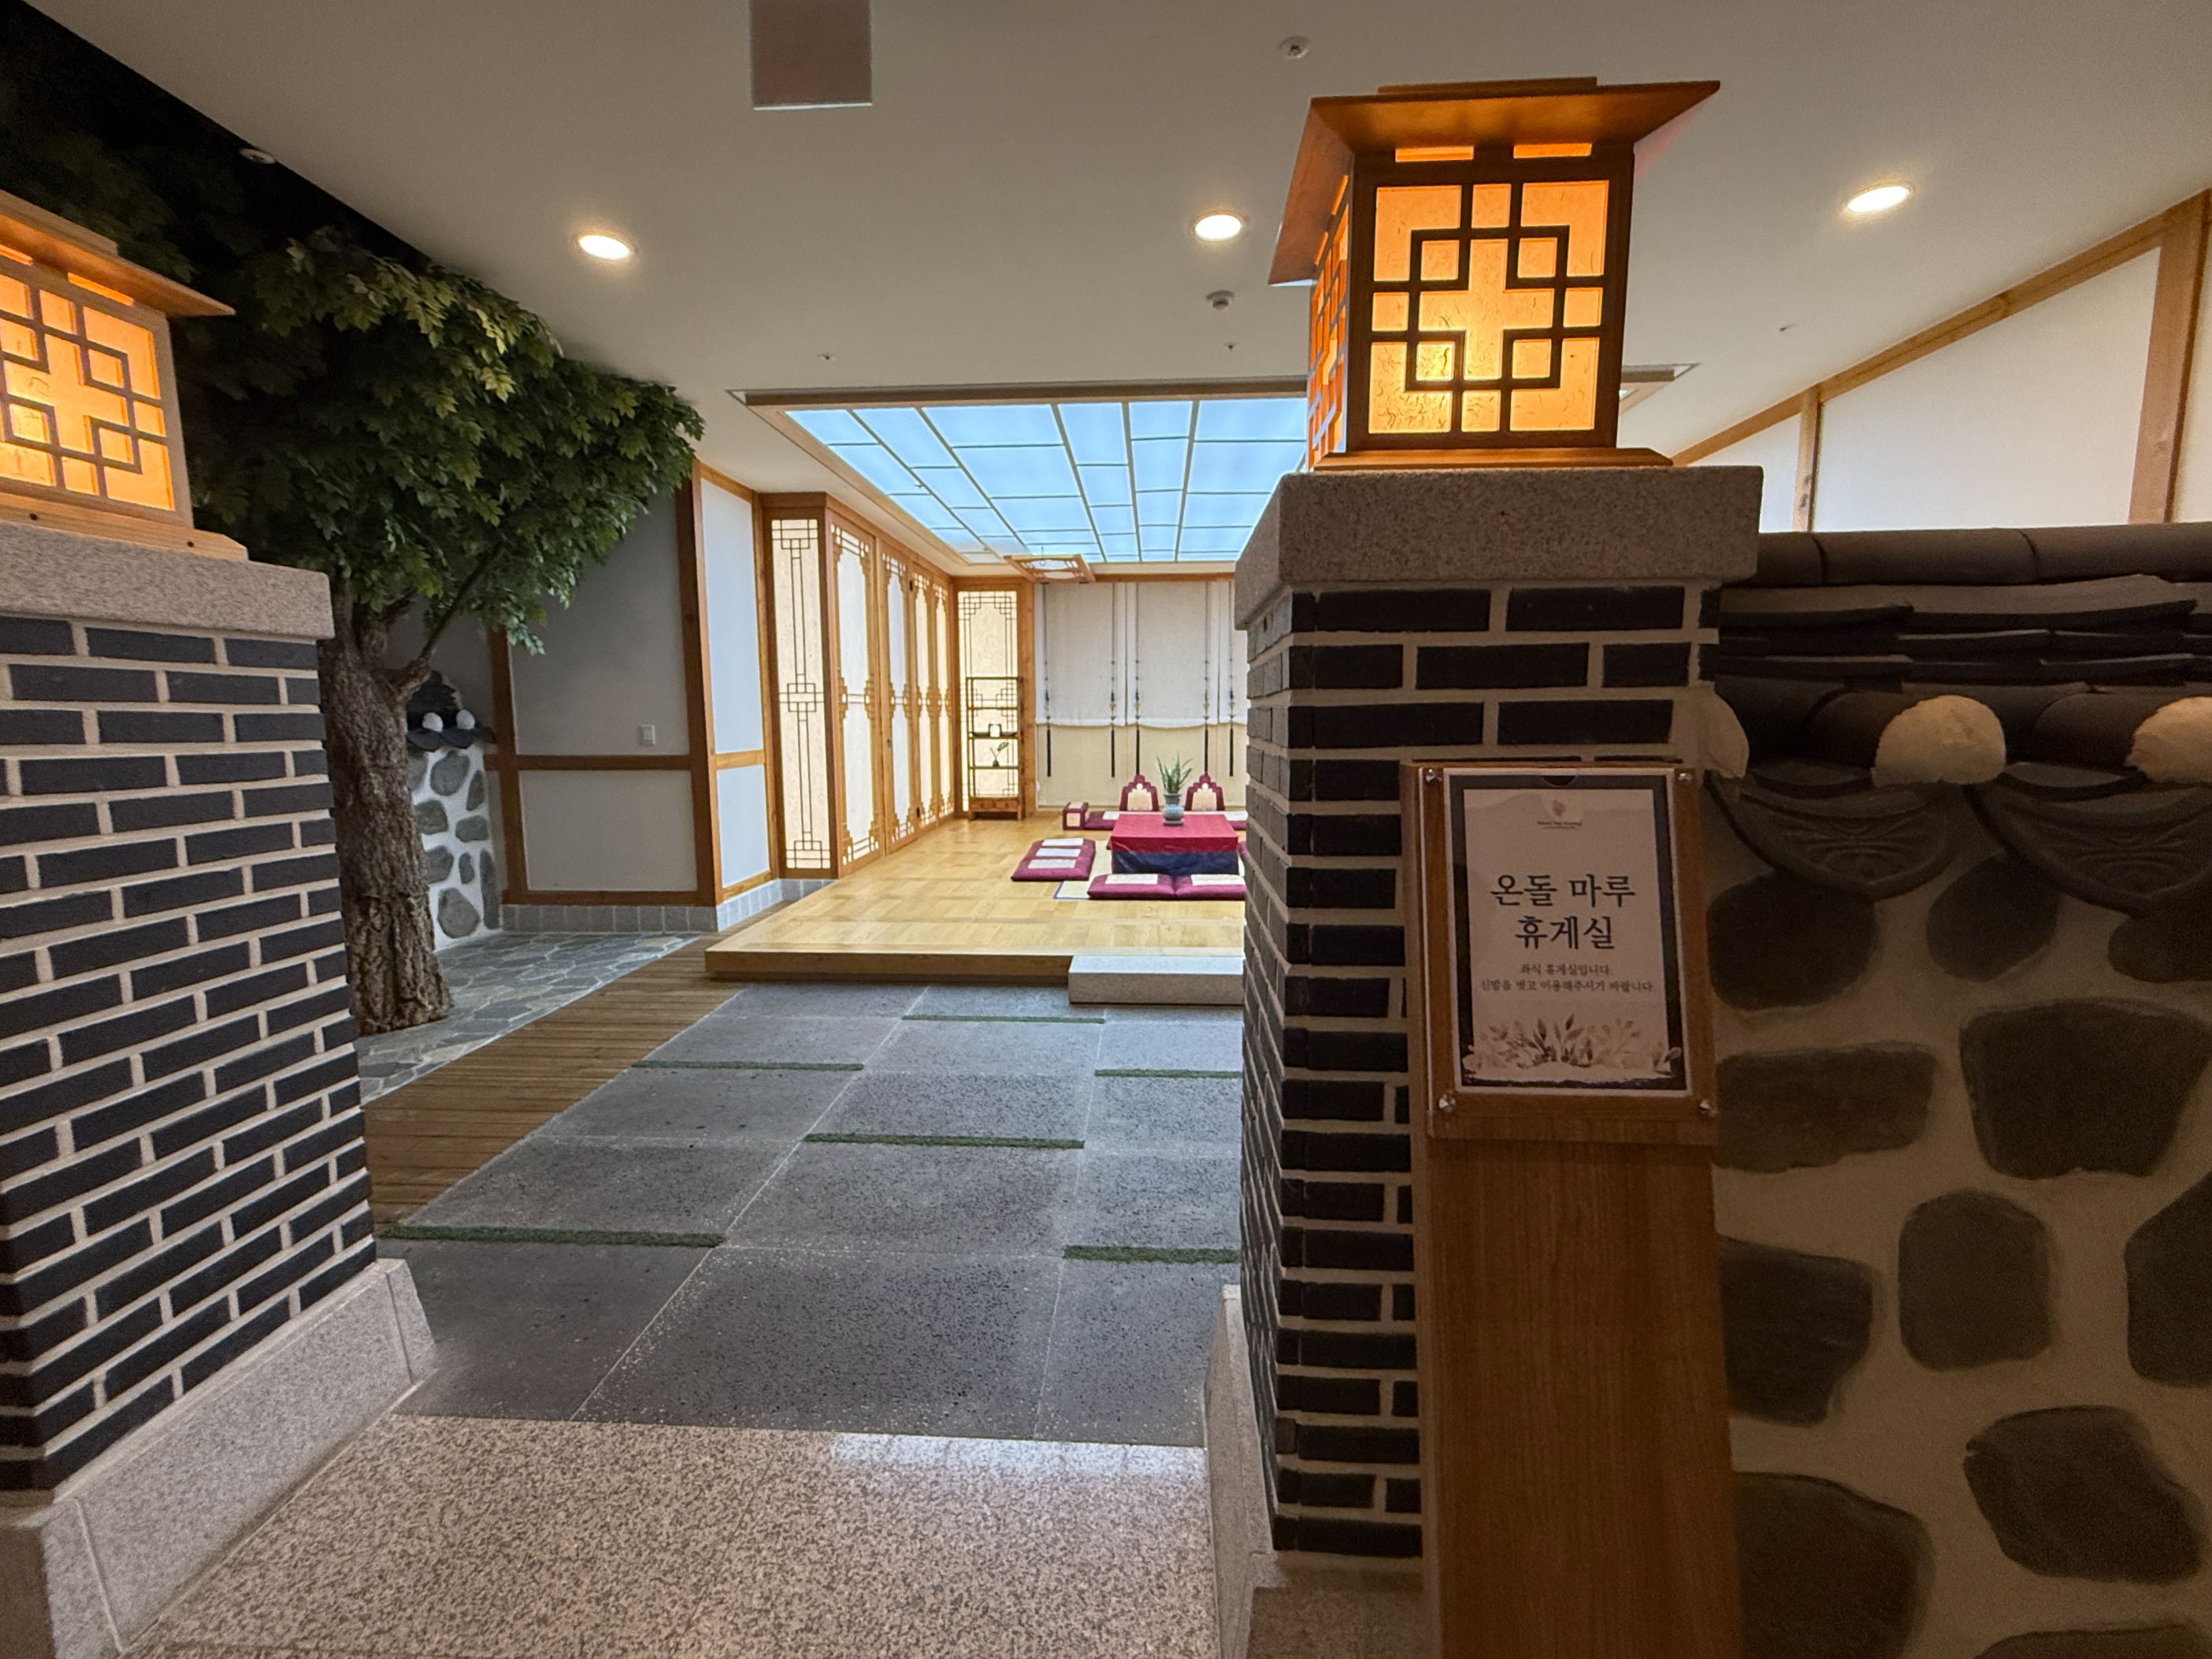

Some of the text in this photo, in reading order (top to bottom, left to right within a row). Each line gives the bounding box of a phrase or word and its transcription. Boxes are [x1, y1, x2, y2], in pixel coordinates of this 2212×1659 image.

[1490, 874, 1635, 907] 온돌 마루
[1515, 915, 1615, 949] 휴게실
[1481, 980, 1511, 991] 신발을
[1516, 980, 1537, 991] 벗고
